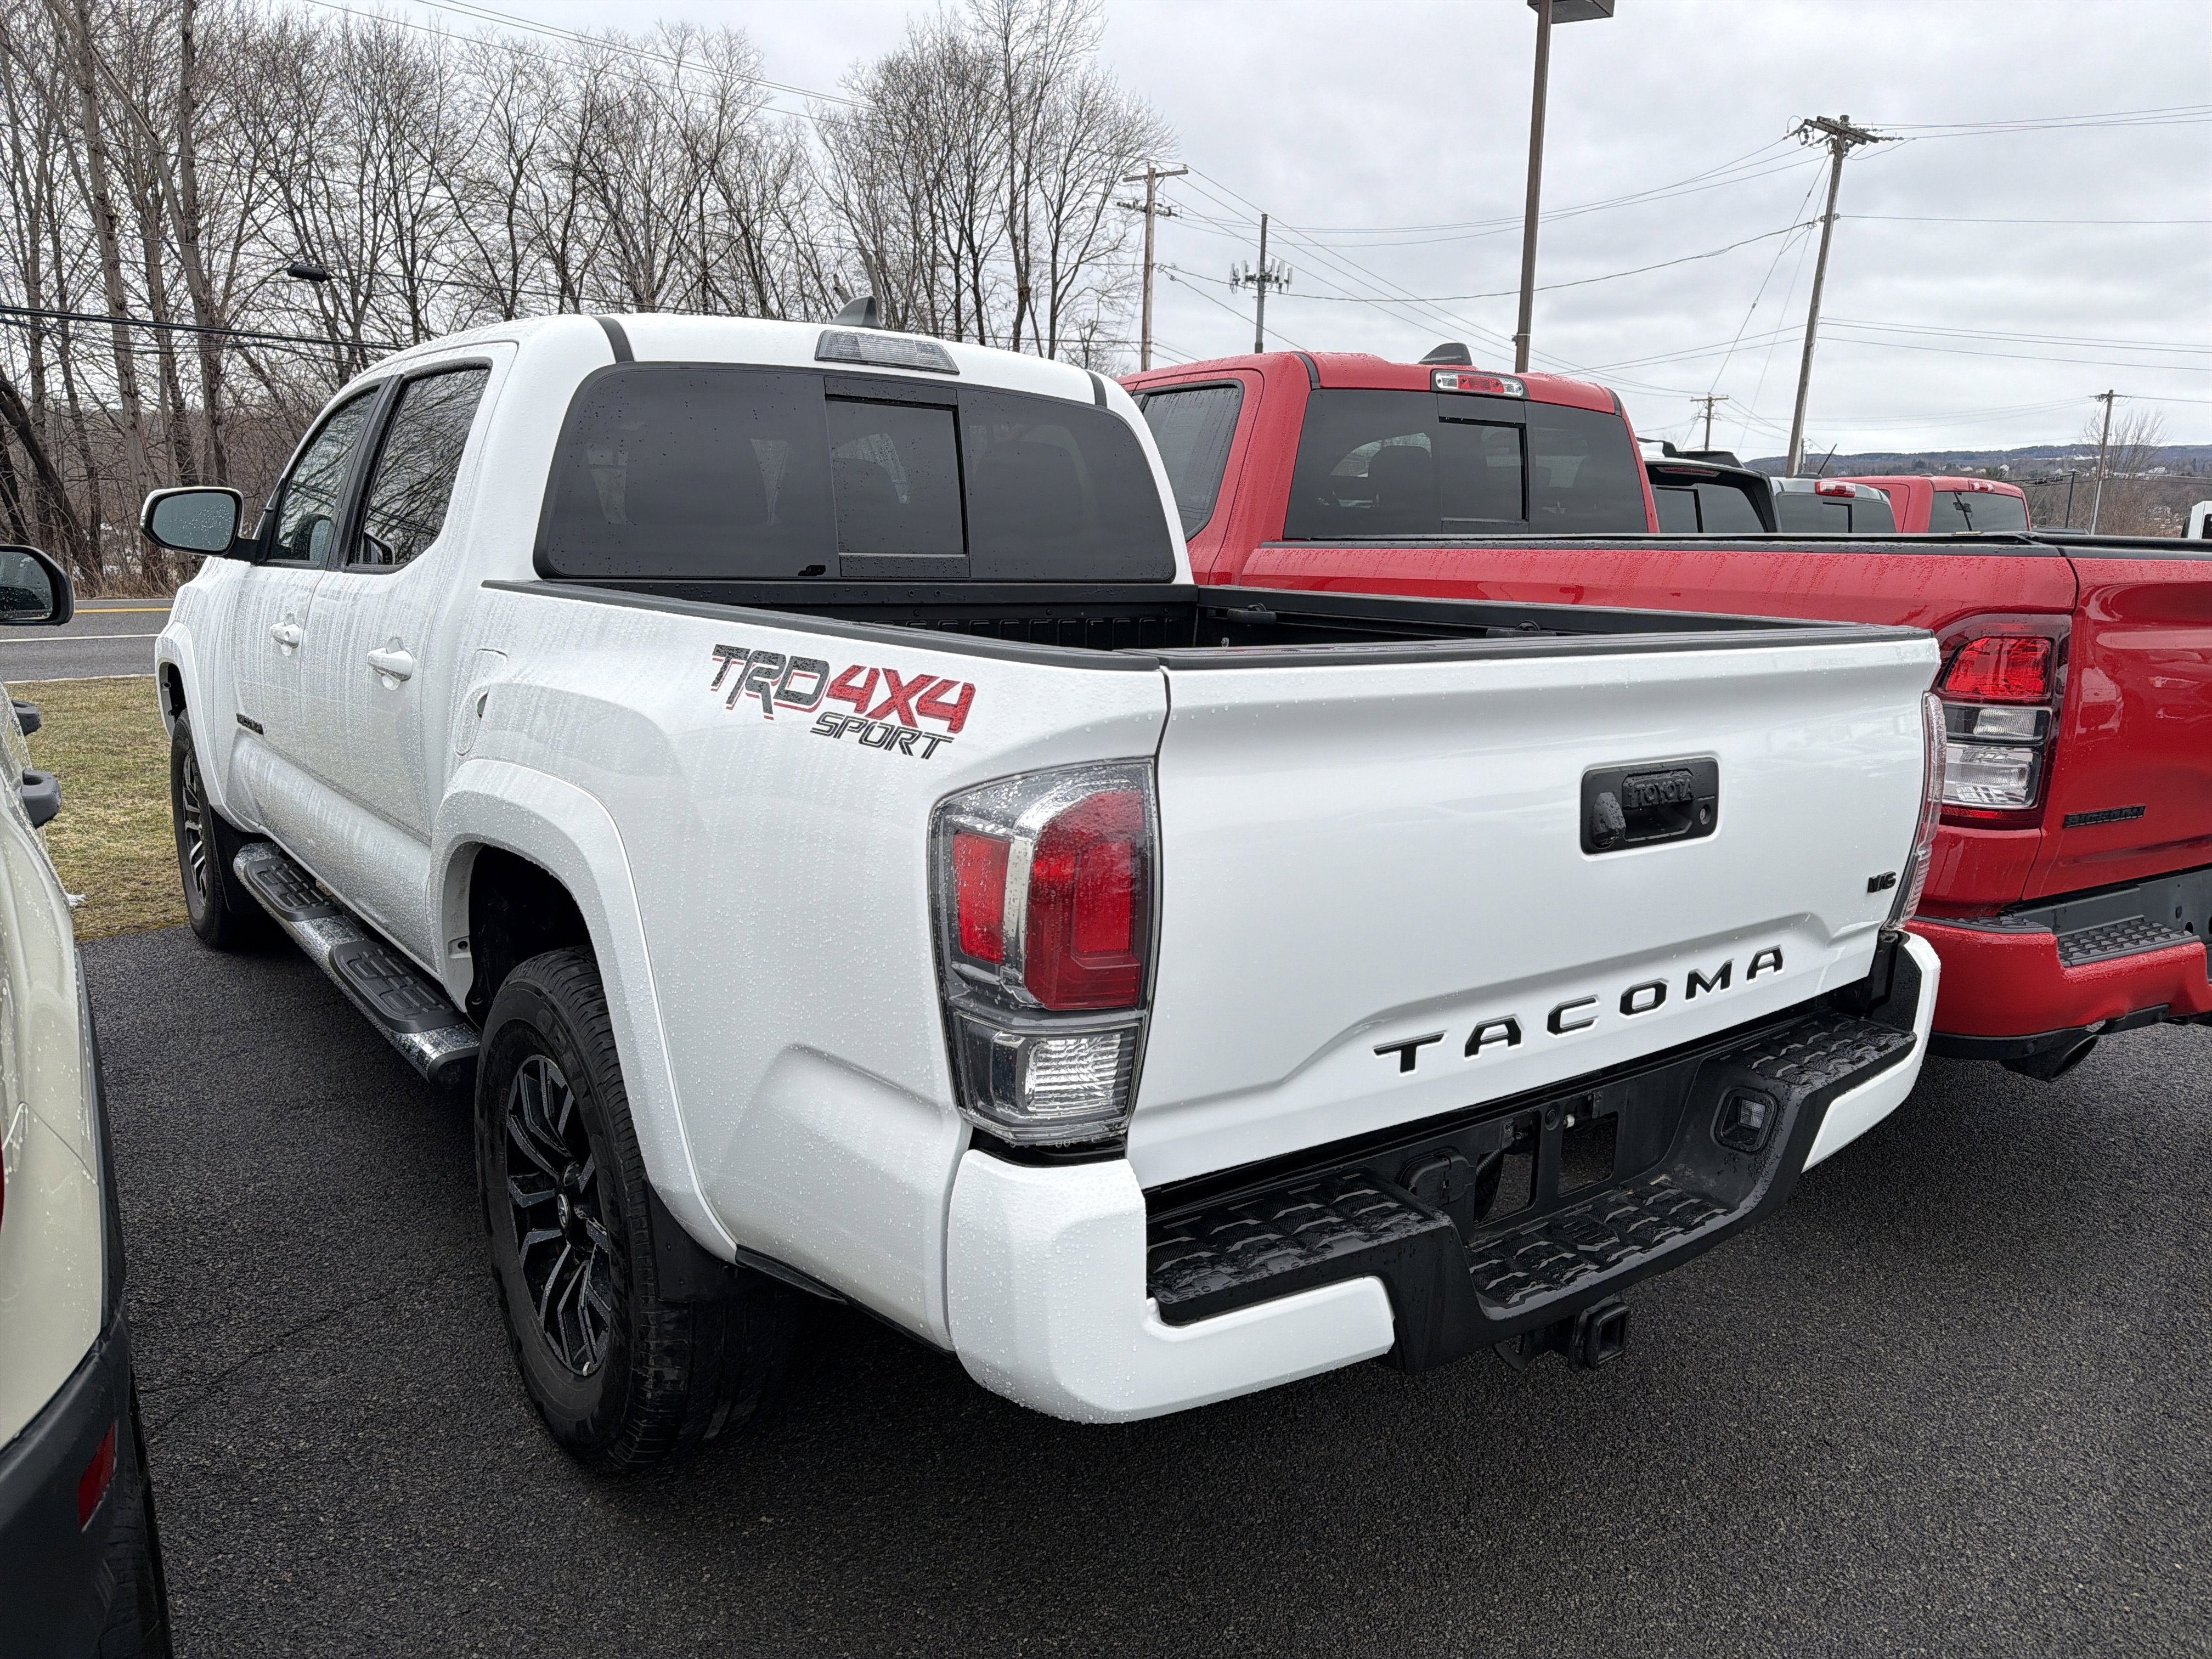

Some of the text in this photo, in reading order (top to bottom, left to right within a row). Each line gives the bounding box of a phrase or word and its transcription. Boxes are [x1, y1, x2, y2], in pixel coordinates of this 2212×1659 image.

[711, 644, 977, 734] TRD 4X4
[810, 712, 955, 760] SPORT
[1634, 778, 1694, 805] TOYOTA
[1373, 945, 1784, 1074] TACOMA
